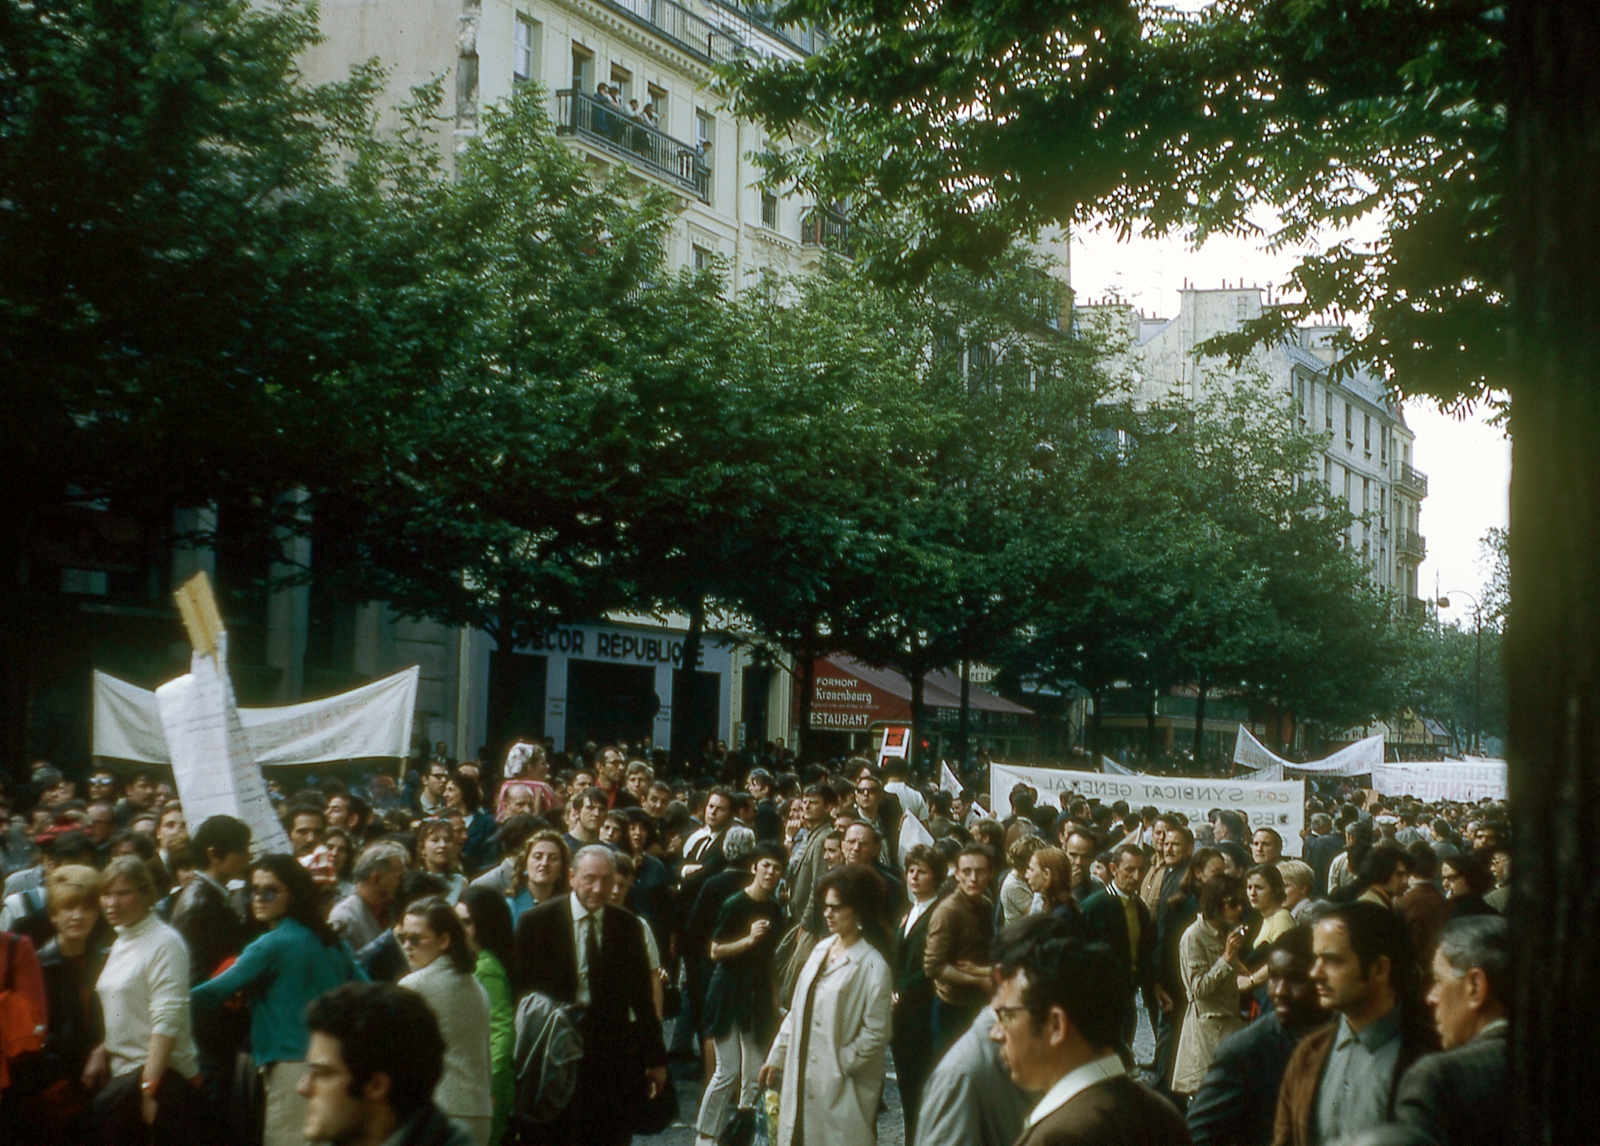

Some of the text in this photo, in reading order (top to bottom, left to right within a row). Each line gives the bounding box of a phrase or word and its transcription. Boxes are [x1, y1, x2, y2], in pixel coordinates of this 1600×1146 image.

[597, 631, 705, 667] RÉPUBLIQE
[816, 677, 858, 688] FORMONT
[816, 688, 872, 704] Kronenbourg
[810, 711, 869, 726] ESTAURANT
